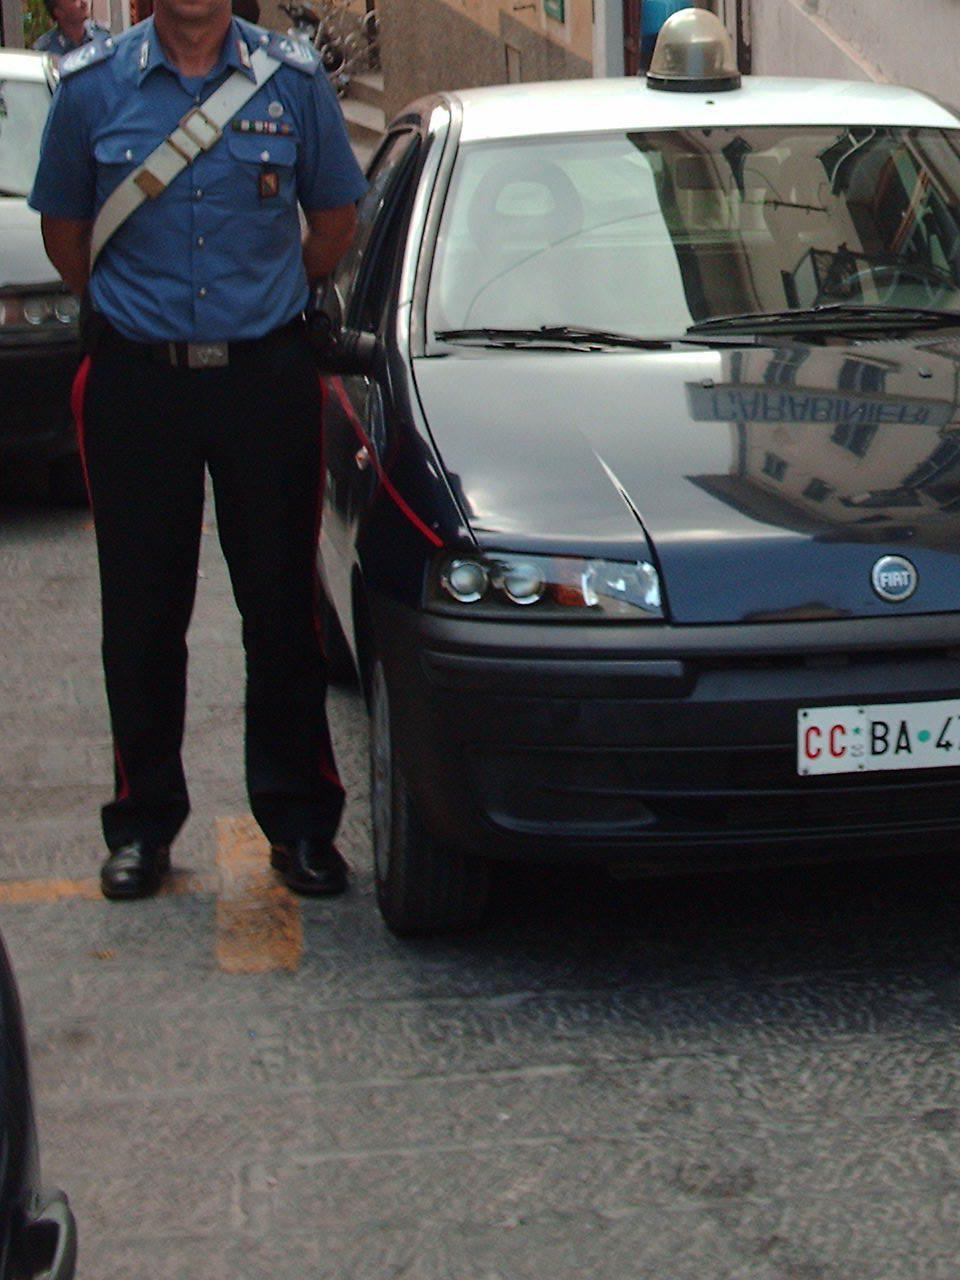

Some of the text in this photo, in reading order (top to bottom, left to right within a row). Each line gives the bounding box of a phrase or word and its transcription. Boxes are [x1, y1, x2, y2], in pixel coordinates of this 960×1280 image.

[880, 570, 909, 588] FIAT
[805, 725, 847, 759] CC
[871, 720, 912, 755] BA
